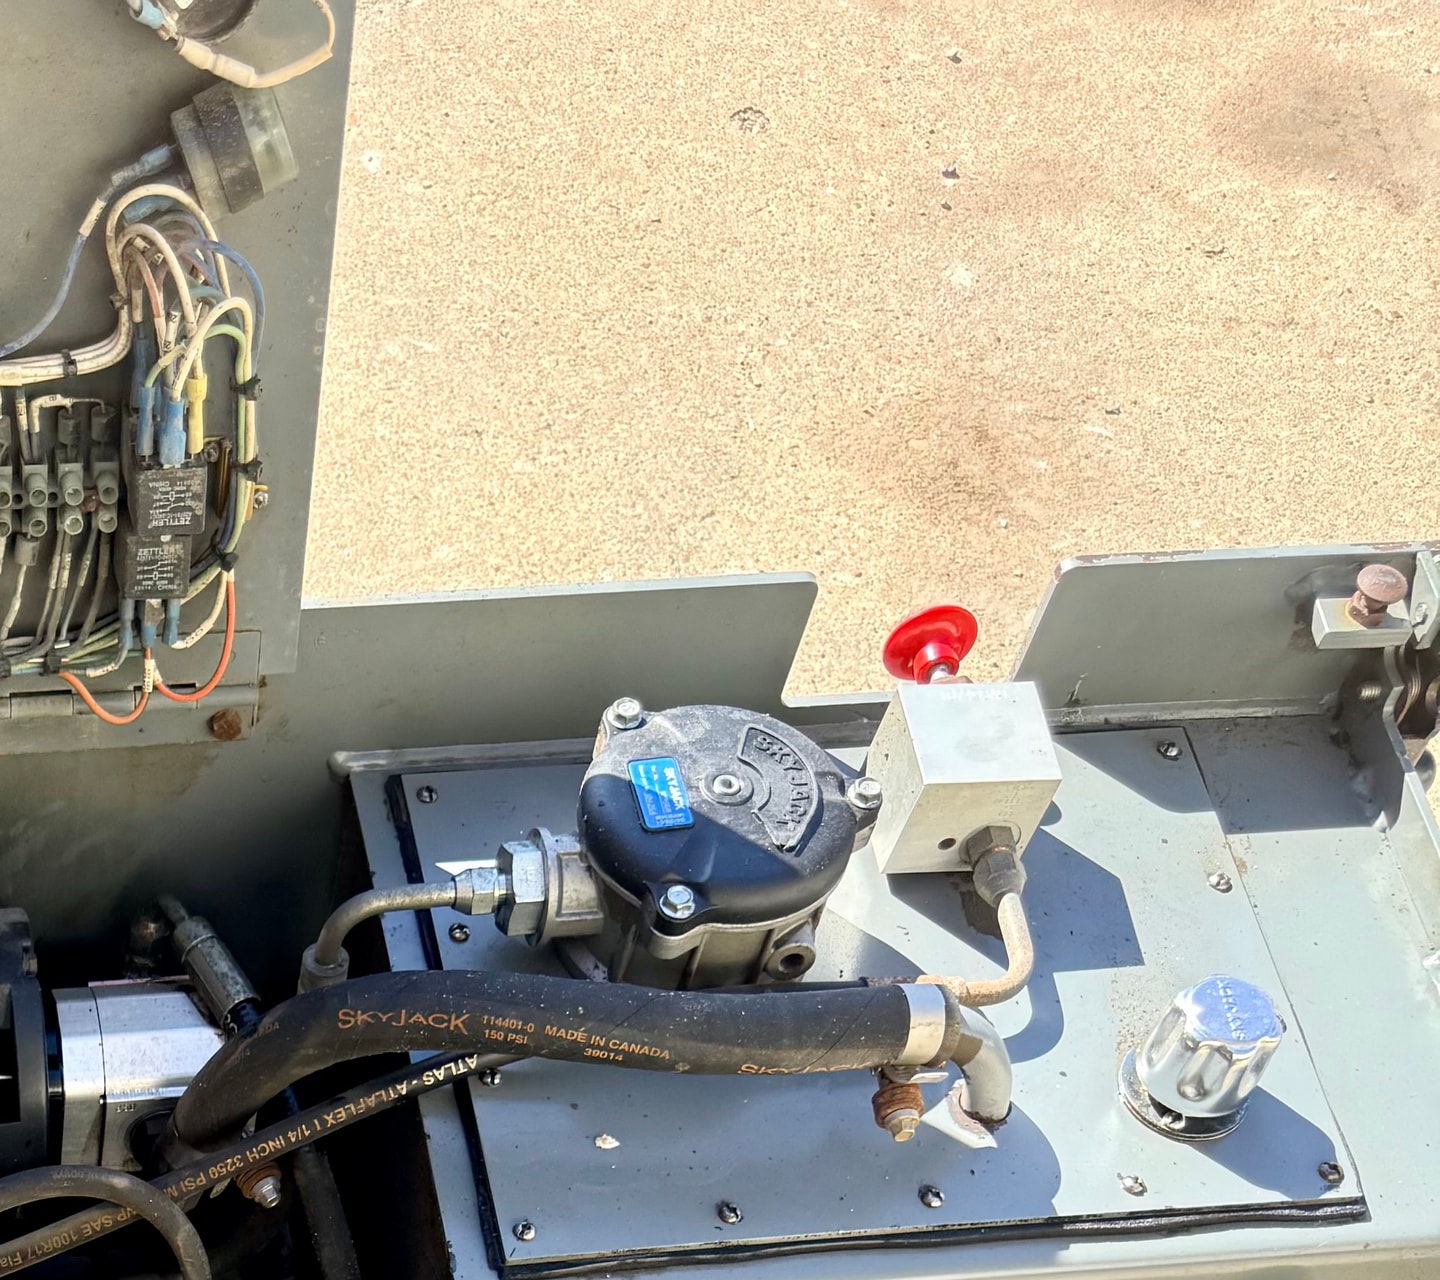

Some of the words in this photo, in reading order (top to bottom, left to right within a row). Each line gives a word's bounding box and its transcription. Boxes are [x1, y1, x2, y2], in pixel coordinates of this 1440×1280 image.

[337, 1007, 469, 1036] SKYJACK
[481, 1015, 535, 1033] 114401-0
[544, 1024, 588, 1044] MADE
[590, 1033, 607, 1048] IN
[609, 1038, 671, 1060] CANADA
[483, 1029, 504, 1042] 150
[506, 1032, 528, 1045] PSI
[583, 1046, 624, 1062] 39014
[421, 1053, 479, 1087] ATLAS
[322, 1079, 408, 1125] ATLAFLEX
[287, 1123, 313, 1143] 1/4
[247, 1135, 288, 1162] INCH
[209, 1155, 245, 1180] 3250
[179, 1174, 207, 1194] PSI
[80, 1214, 113, 1238] SAE
[26, 1230, 79, 1260] 100R17
